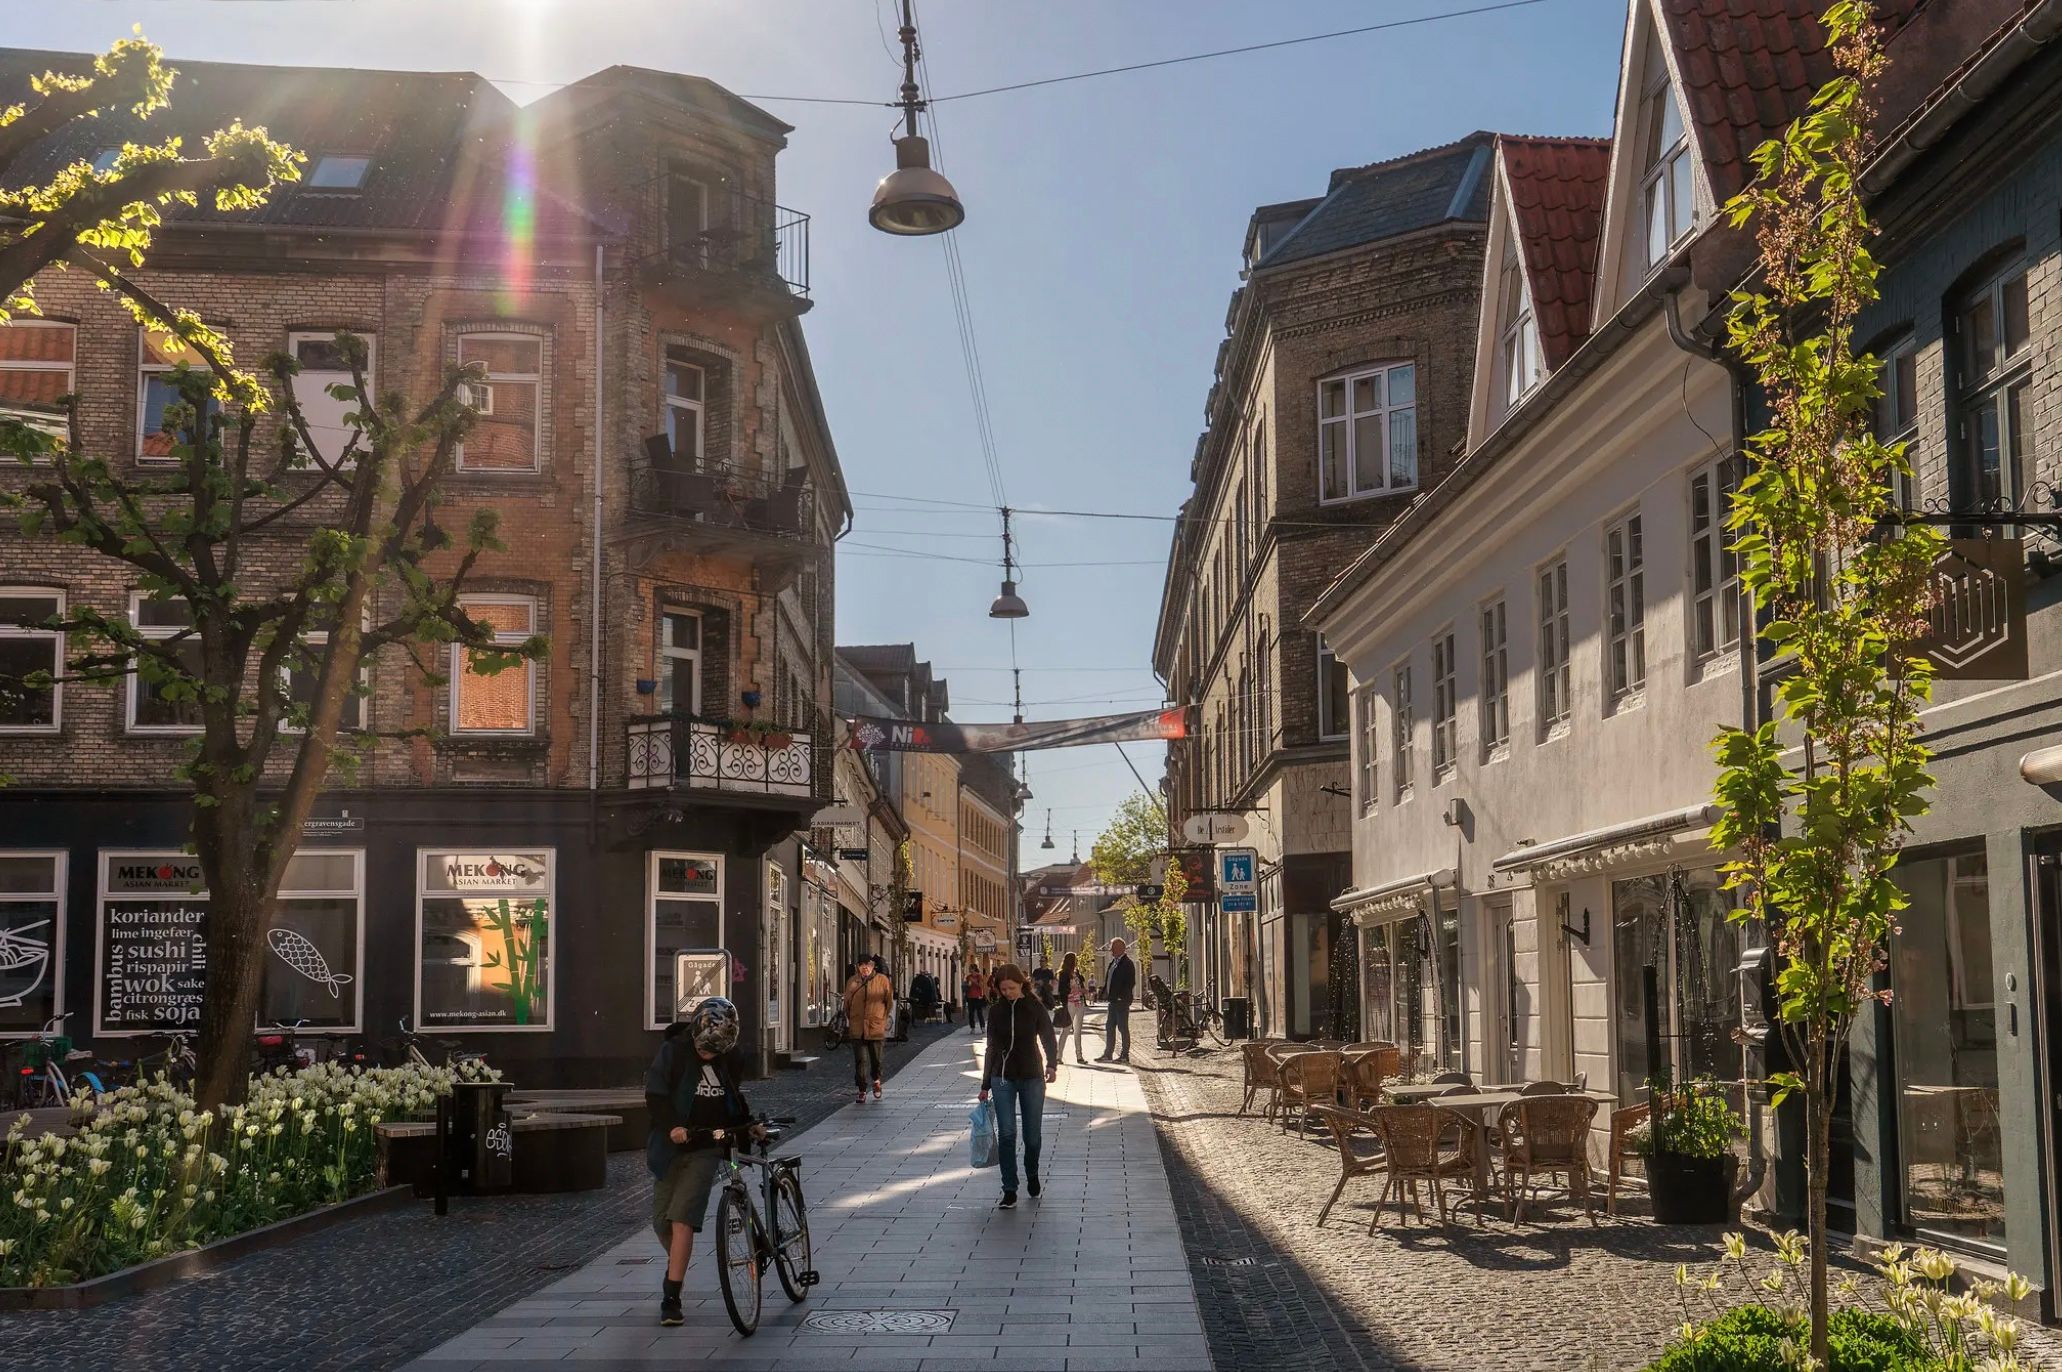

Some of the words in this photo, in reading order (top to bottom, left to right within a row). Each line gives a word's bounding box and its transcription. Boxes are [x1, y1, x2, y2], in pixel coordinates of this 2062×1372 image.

[303, 820, 355, 828] ergravensgade
[118, 865, 200, 880] MEKONG
[447, 864, 525, 878] MEKONG
[481, 878, 517, 886] MARKET
[111, 908, 205, 923] koriander
[112, 928, 139, 939] lime
[141, 927, 194, 940] ingefær
[128, 941, 186, 959] sushi
[192, 934, 207, 969] chili
[127, 961, 189, 976] rispapir
[105, 945, 124, 1022] bambus
[124, 974, 176, 993] wok
[177, 978, 205, 989] sake
[123, 993, 204, 1006] citrongræs
[126, 1010, 149, 1020] fisk
[154, 1003, 201, 1025] soja
[430, 1010, 507, 1018] www.mekong-asian.dk
[694, 1084, 725, 1097] didas
